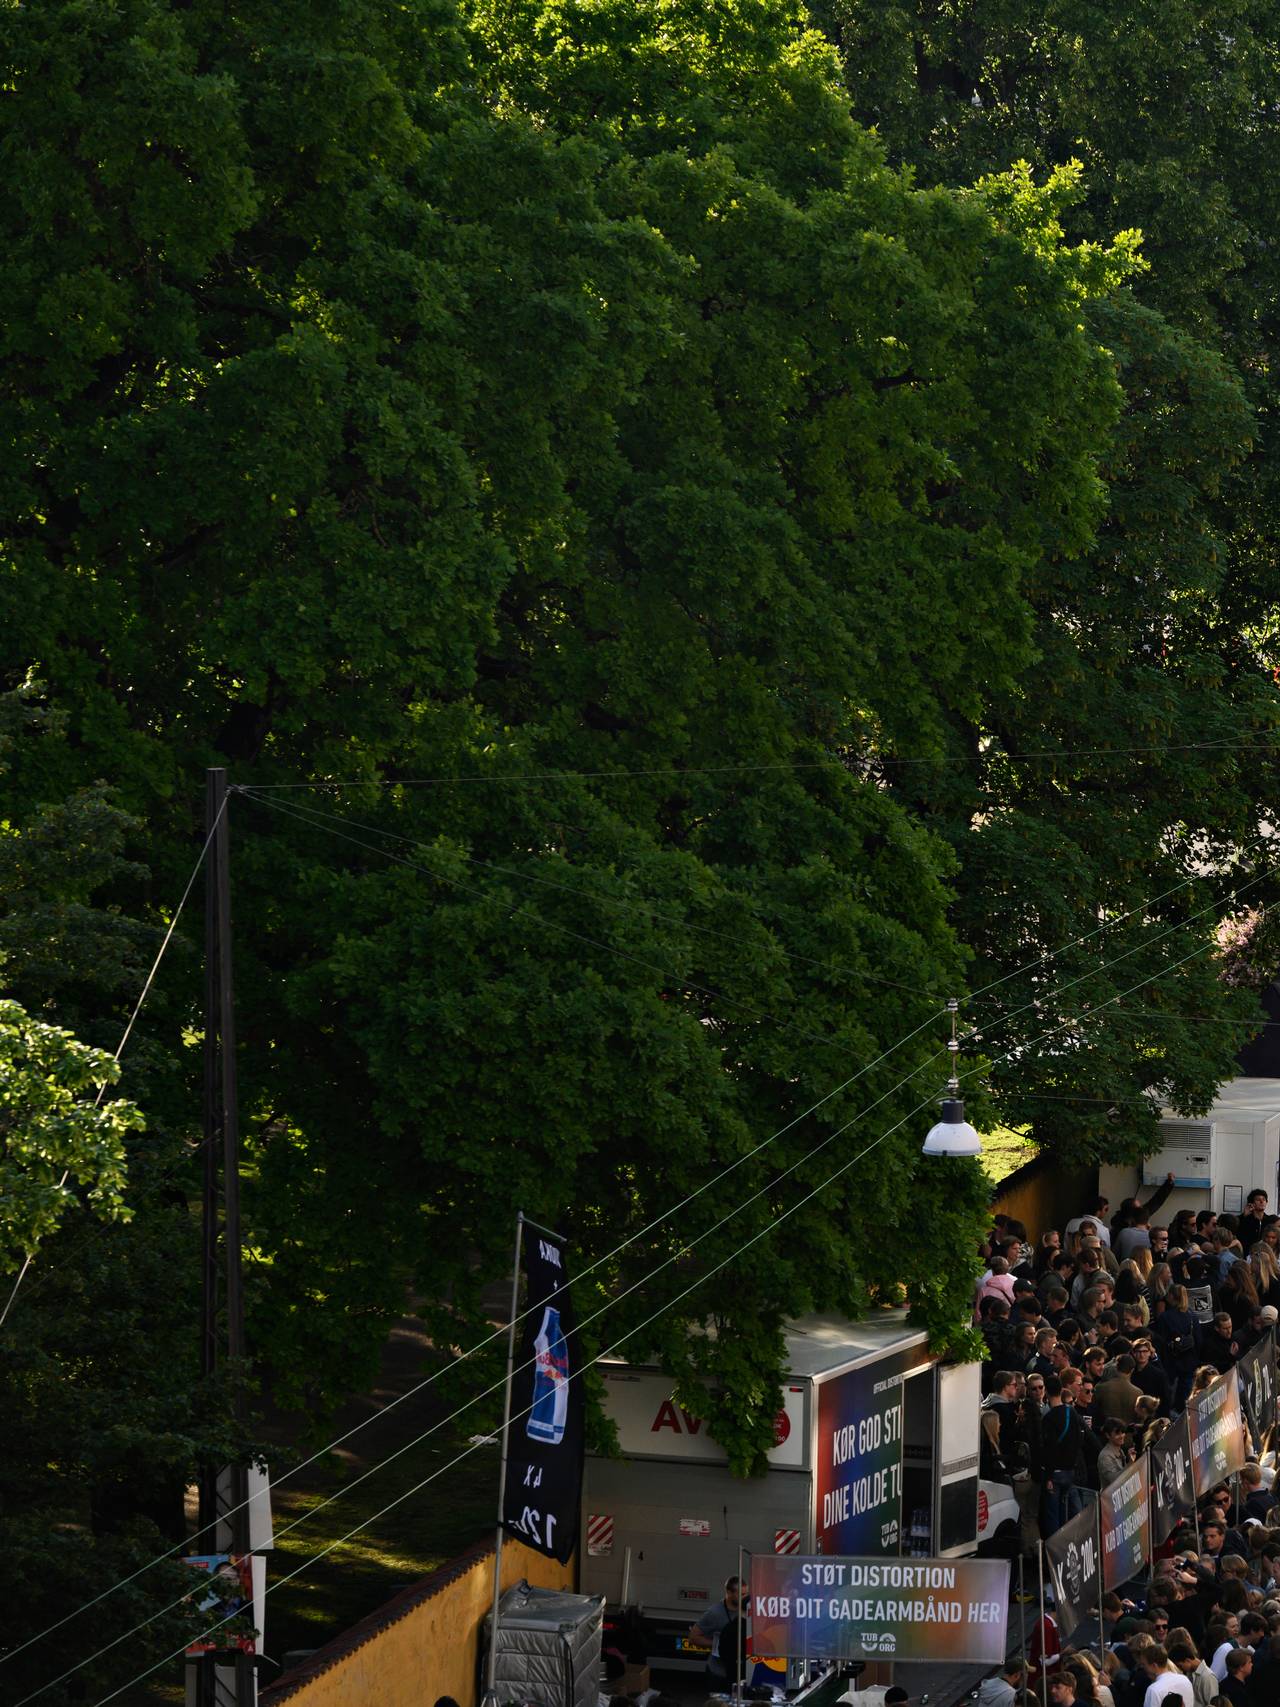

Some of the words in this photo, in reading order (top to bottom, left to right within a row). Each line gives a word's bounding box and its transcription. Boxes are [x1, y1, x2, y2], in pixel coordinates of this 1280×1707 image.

[651, 1400, 705, 1435] AV
[833, 1424, 856, 1467] KØR
[859, 1414, 881, 1455] GOD
[823, 1485, 850, 1529] DINE
[853, 1468, 887, 1518] KOLDE
[802, 1563, 846, 1586] STØT
[851, 1565, 955, 1589] DISTORTION
[756, 1596, 790, 1618] KØB
[796, 1598, 826, 1619] DIT
[829, 1596, 962, 1623] GADEARMBÅND
[968, 1602, 1000, 1623] HER
[861, 1633, 878, 1642] TUB
[879, 1643, 896, 1652] ORG
